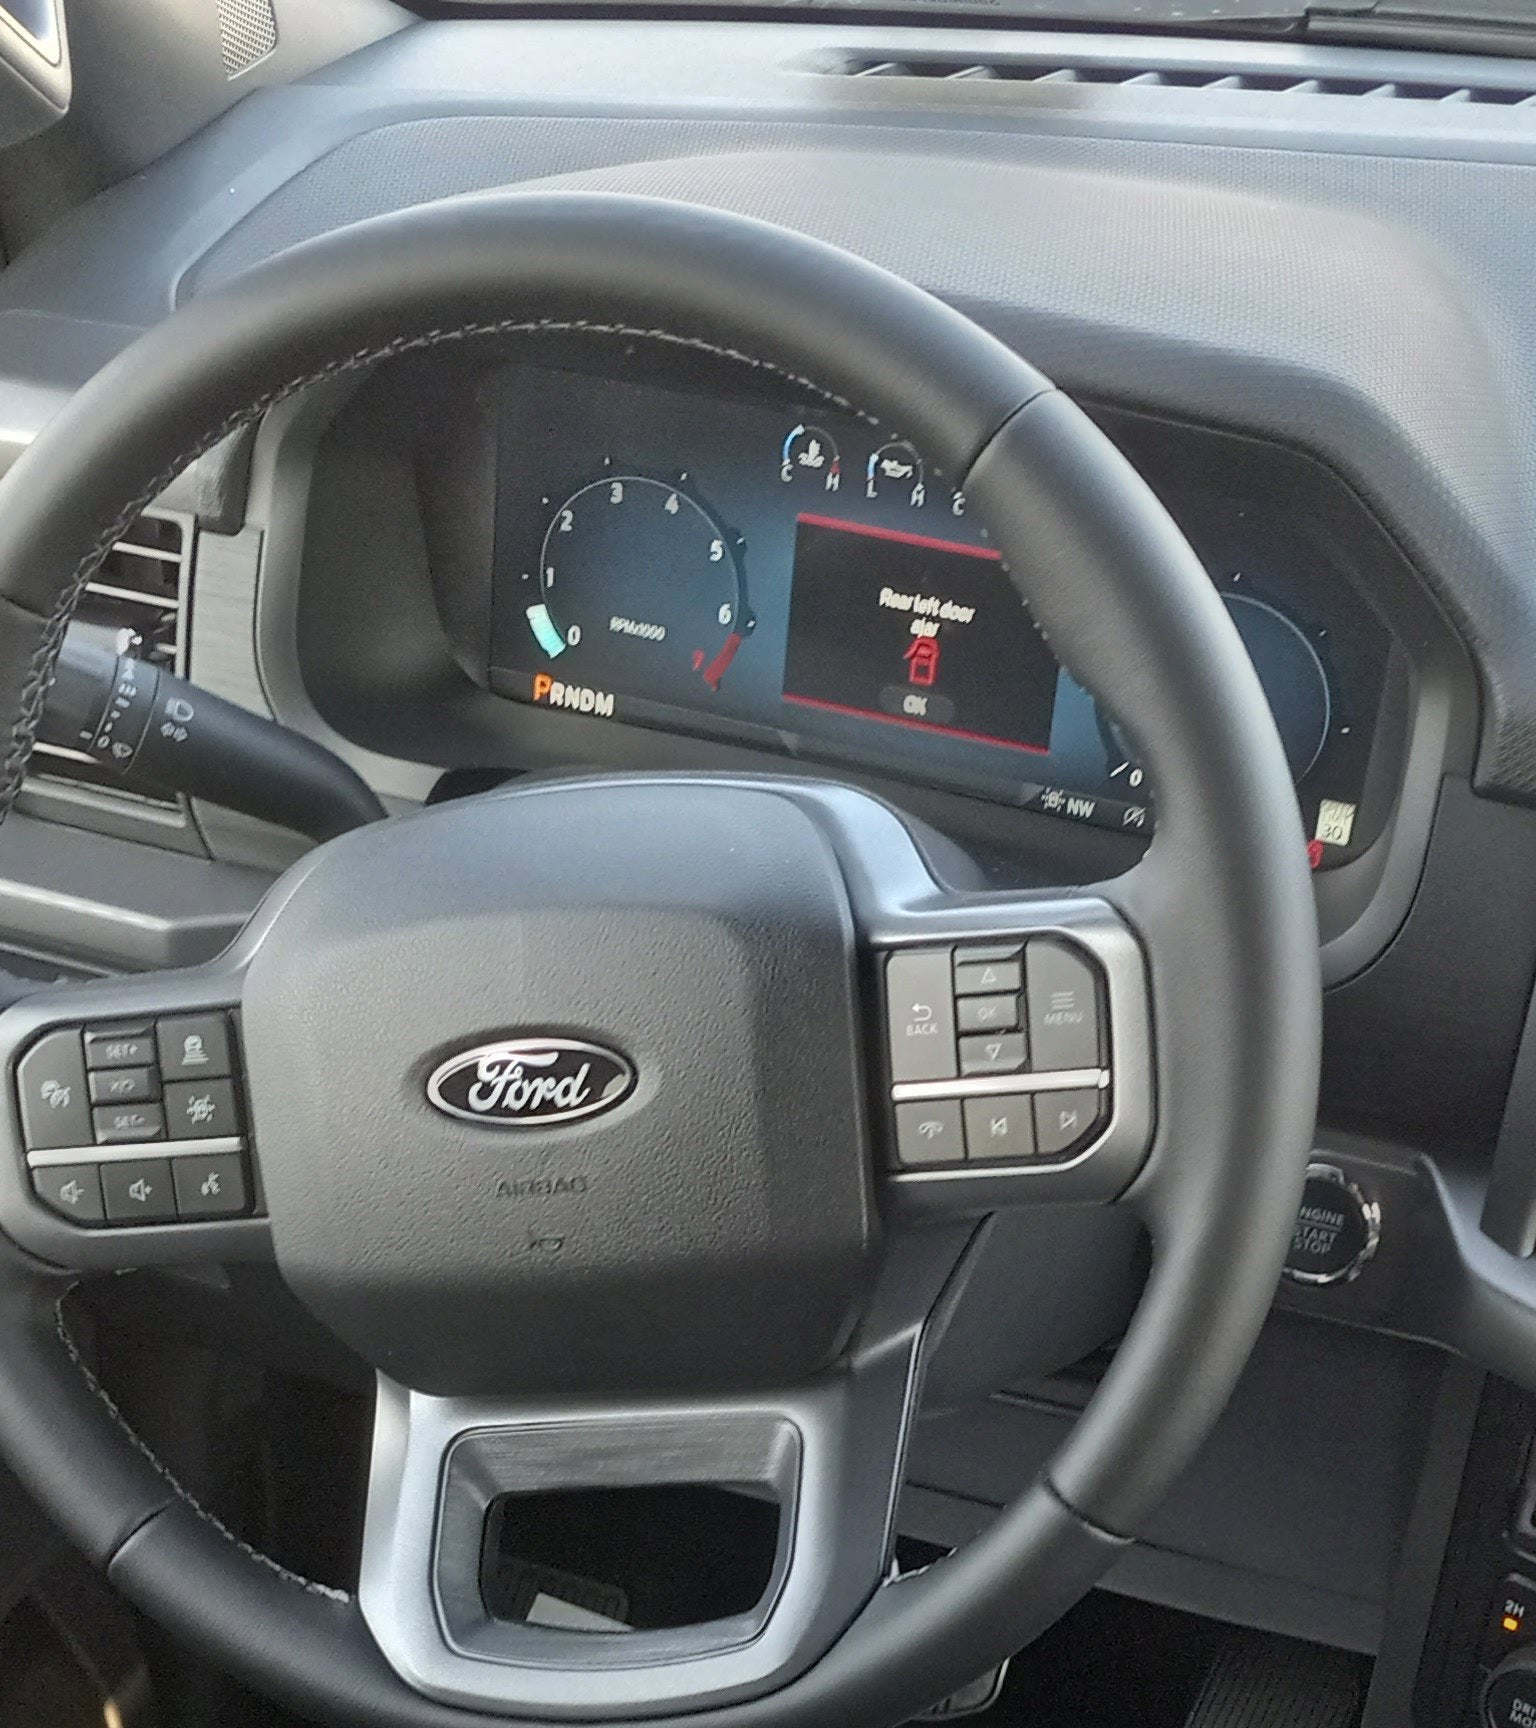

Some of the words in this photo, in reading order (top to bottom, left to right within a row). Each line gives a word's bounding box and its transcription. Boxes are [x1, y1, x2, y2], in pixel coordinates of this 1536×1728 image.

[610, 482, 623, 504] 3
[664, 493, 679, 515] 4
[560, 510, 573, 531] 2
[709, 539, 723, 561] 5
[546, 567, 555, 588] 1
[718, 604, 732, 625] 6
[879, 587, 914, 611] Rear
[913, 594, 941, 616] left
[939, 600, 976, 624] door
[567, 625, 581, 645] 0
[1067, 797, 1095, 819] NW
[906, 1022, 939, 1037] BACK
[468, 1051, 591, 1112] Ford
[1299, 1206, 1344, 1226] NGINE
[1504, 1599, 1525, 1618] 2H
